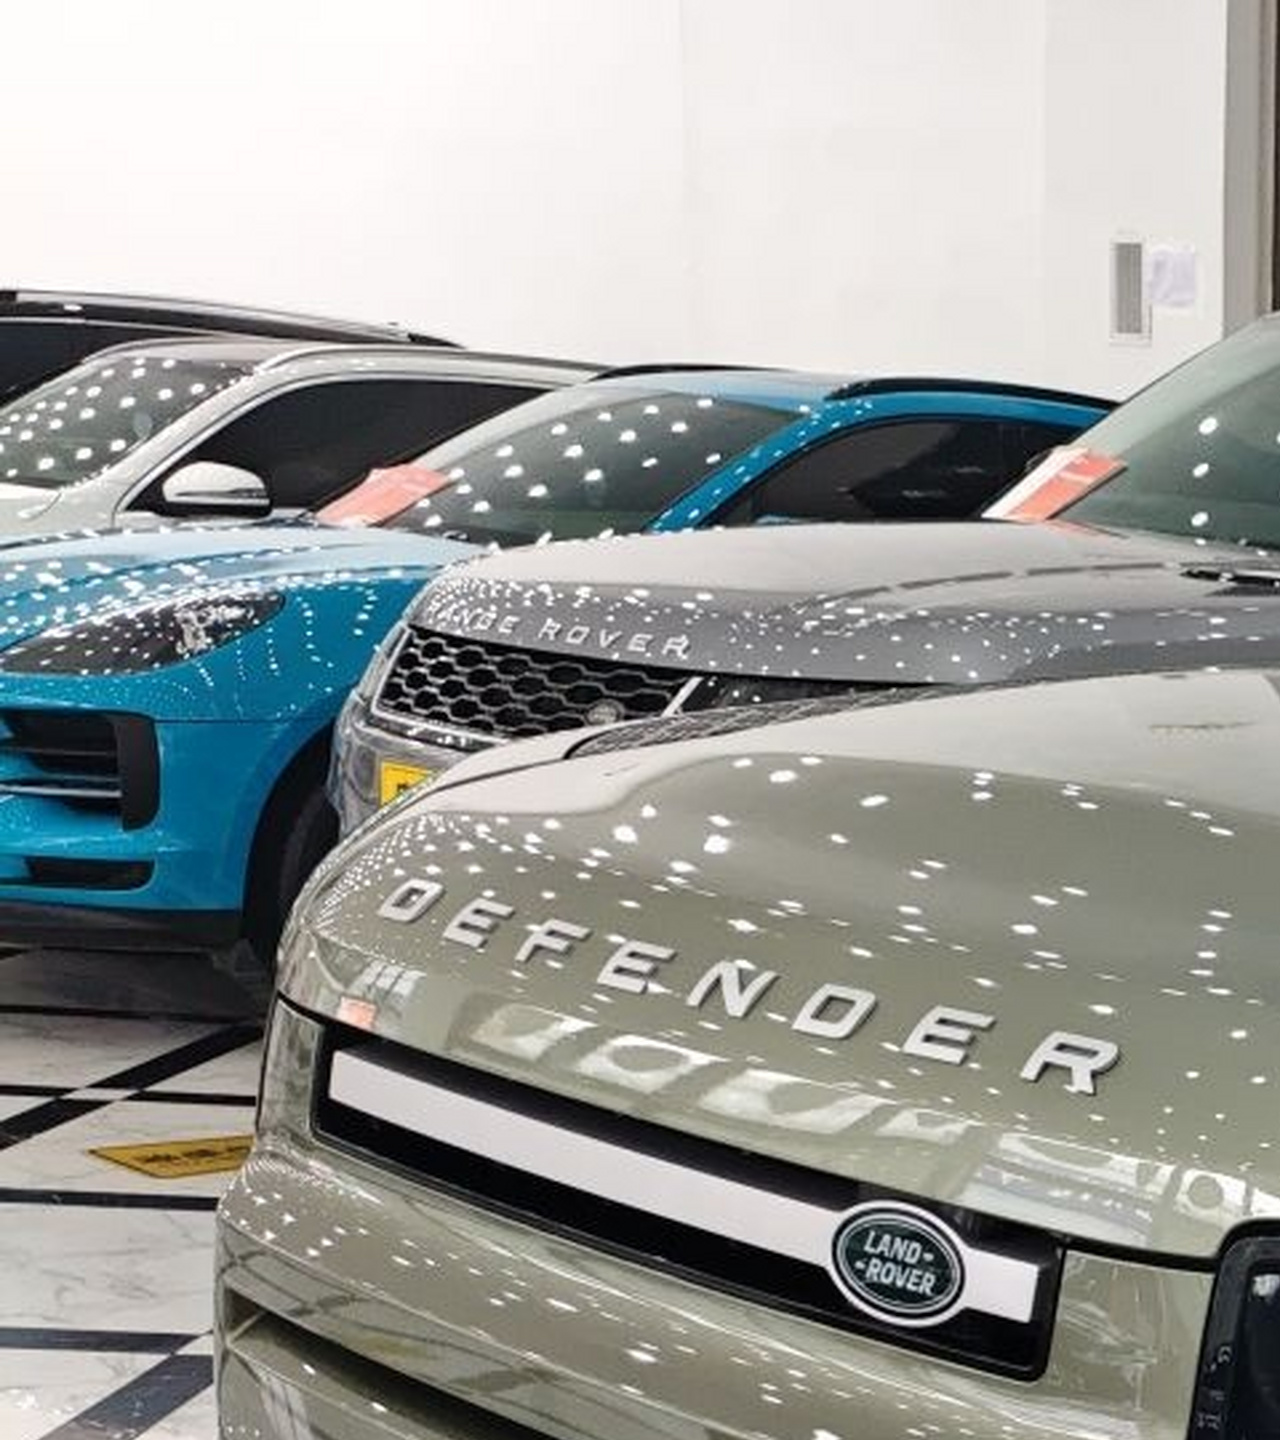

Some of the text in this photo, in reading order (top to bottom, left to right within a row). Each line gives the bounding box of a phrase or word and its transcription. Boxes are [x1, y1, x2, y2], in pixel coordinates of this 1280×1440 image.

[426, 603, 690, 660] RANGE ROVER
[377, 878, 1119, 1095] DEFENDER
